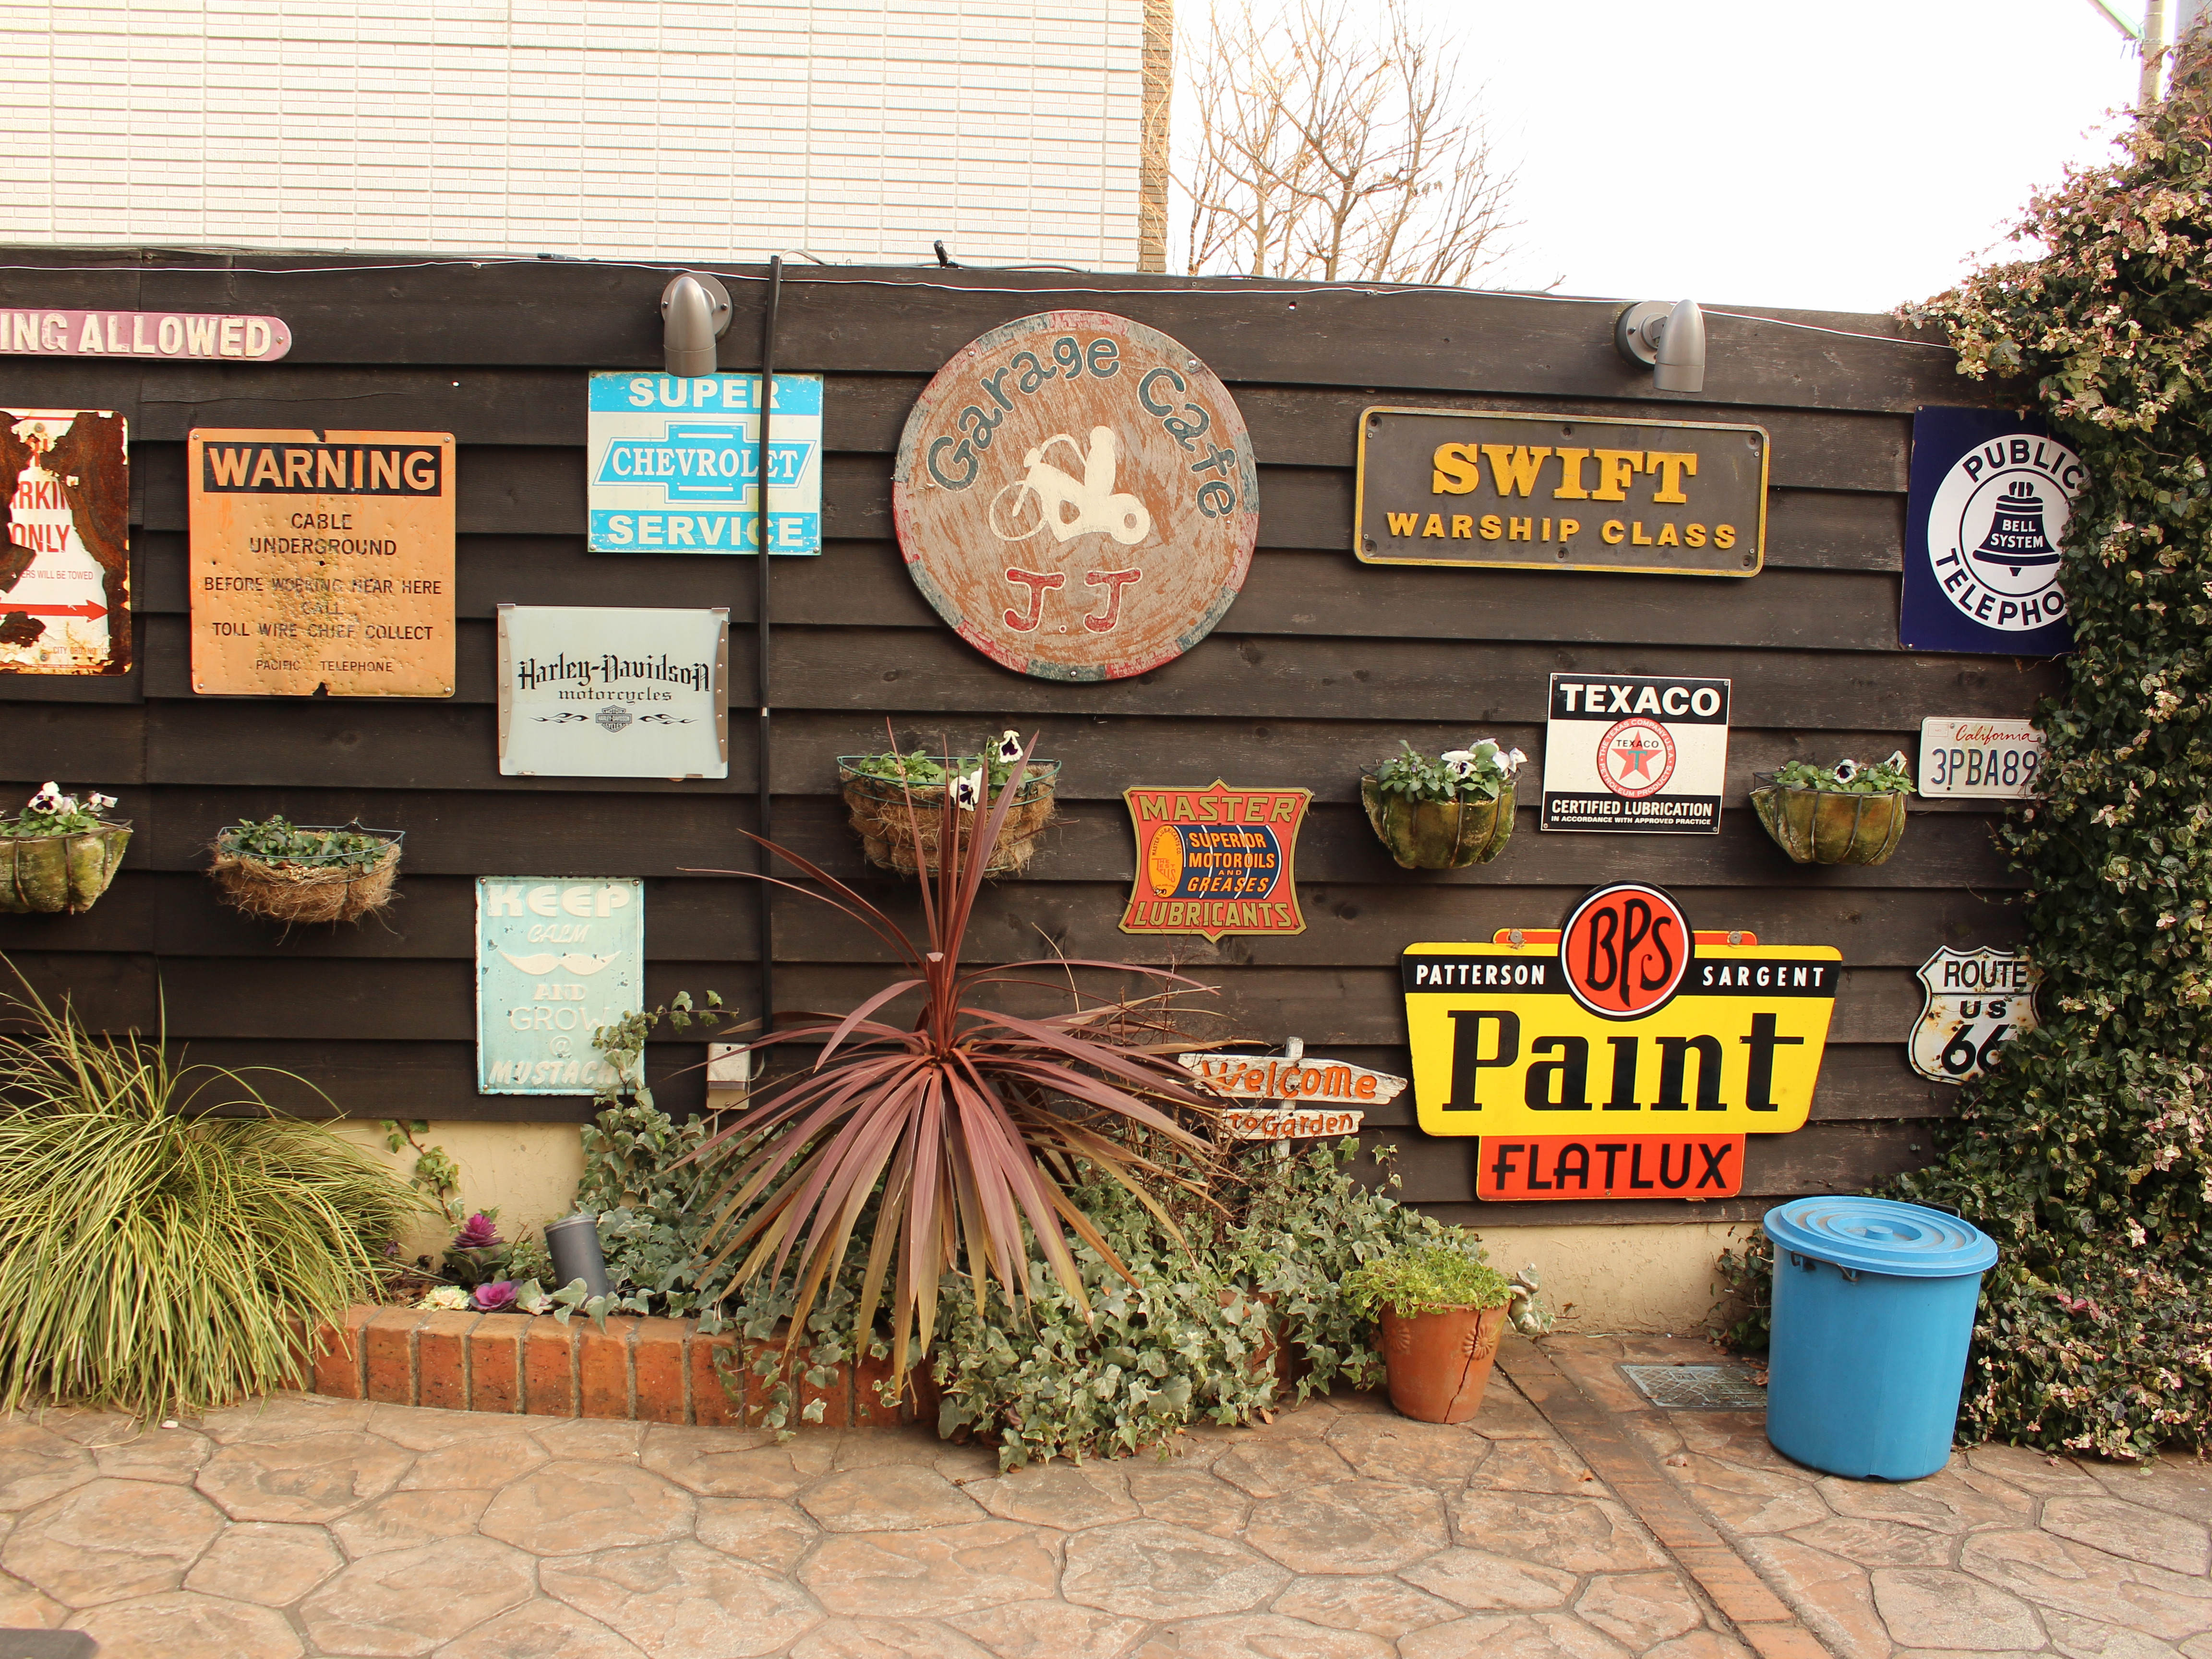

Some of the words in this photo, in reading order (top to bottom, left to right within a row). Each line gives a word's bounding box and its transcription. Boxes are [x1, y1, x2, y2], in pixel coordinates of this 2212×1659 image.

[78, 314, 271, 357] ALLOWED
[628, 378, 781, 409] SUPER
[927, 336, 1120, 492] Garage
[1137, 366, 1238, 519] Cafe
[209, 447, 435, 491] WARNING
[612, 447, 799, 478] CHEVROLET
[1432, 442, 1697, 504] SWIFT
[1962, 439, 2084, 490] PUBLIC
[291, 513, 352, 530] CABLE
[608, 515, 803, 546] SERVICE
[1386, 512, 1580, 542] WARSHIP
[1601, 519, 1736, 549] CLASS
[2002, 519, 2036, 532] BELL
[11, 523, 71, 553] ONLY
[250, 537, 397, 555] UNDERGROUND
[1990, 533, 2044, 548] SYSTEM
[37, 570, 55, 579] WILL
[57, 571, 66, 579] BE
[68, 571, 94, 580] TOWED
[205, 577, 264, 591] BEFORE
[272, 578, 343, 592] WORKING
[351, 578, 393, 594] NEAR
[402, 580, 442, 594] HERE
[1936, 547, 2064, 626] TELEPHO
[303, 601, 344, 615] CALL
[212, 622, 250, 637] TOLL
[258, 623, 298, 637] WIRE
[308, 623, 355, 638] CHIEF
[365, 625, 433, 640] COLLECT
[256, 660, 301, 671] PACIFIC
[320, 661, 393, 672] TELEPHONE
[558, 686, 673, 705] motorcycles
[1559, 683, 1720, 717] TEXACO
[1599, 740, 1609, 757] THE
[1605, 721, 1629, 739] TEXAS
[1631, 719, 1667, 737] COMPANY
[1616, 739, 1659, 748] TEXACO
[1955, 724, 2039, 745] California
[1599, 763, 1635, 796] PETROLEUM
[1637, 765, 1672, 796] PRODUCTS
[1931, 748, 2038, 786] 3PBA89
[1139, 795, 1297, 822] MASTER
[1551, 800, 1621, 815] CERTIFIED
[1624, 801, 1712, 817] LUBRICATION
[1152, 837, 1160, 856] MASTER
[1158, 828, 1181, 846] LUBRICANTS
[1188, 832, 1268, 848] SUPERIOR
[1187, 876, 1270, 892] GREASES
[487, 885, 630, 917] KEEP
[1133, 902, 1292, 927] LUBRICANTS
[528, 925, 591, 943] CALM
[1585, 898, 1673, 1008] BPS
[1416, 963, 1546, 986] PATTERSON
[1702, 966, 1824, 987] SARGENT
[1944, 960, 2028, 987] ROUTE
[533, 984, 586, 1001] AND
[509, 1007, 609, 1031] GROW
[549, 1035, 572, 1058] @
[1941, 1024, 2010, 1075] 66
[489, 1060, 623, 1085] MUSTACH
[1442, 1010, 1804, 1112] Paint
[1202, 1060, 1377, 1099] Welcome
[1262, 1114, 1353, 1138] Garden
[1491, 1142, 1732, 1190] FLATLUX
